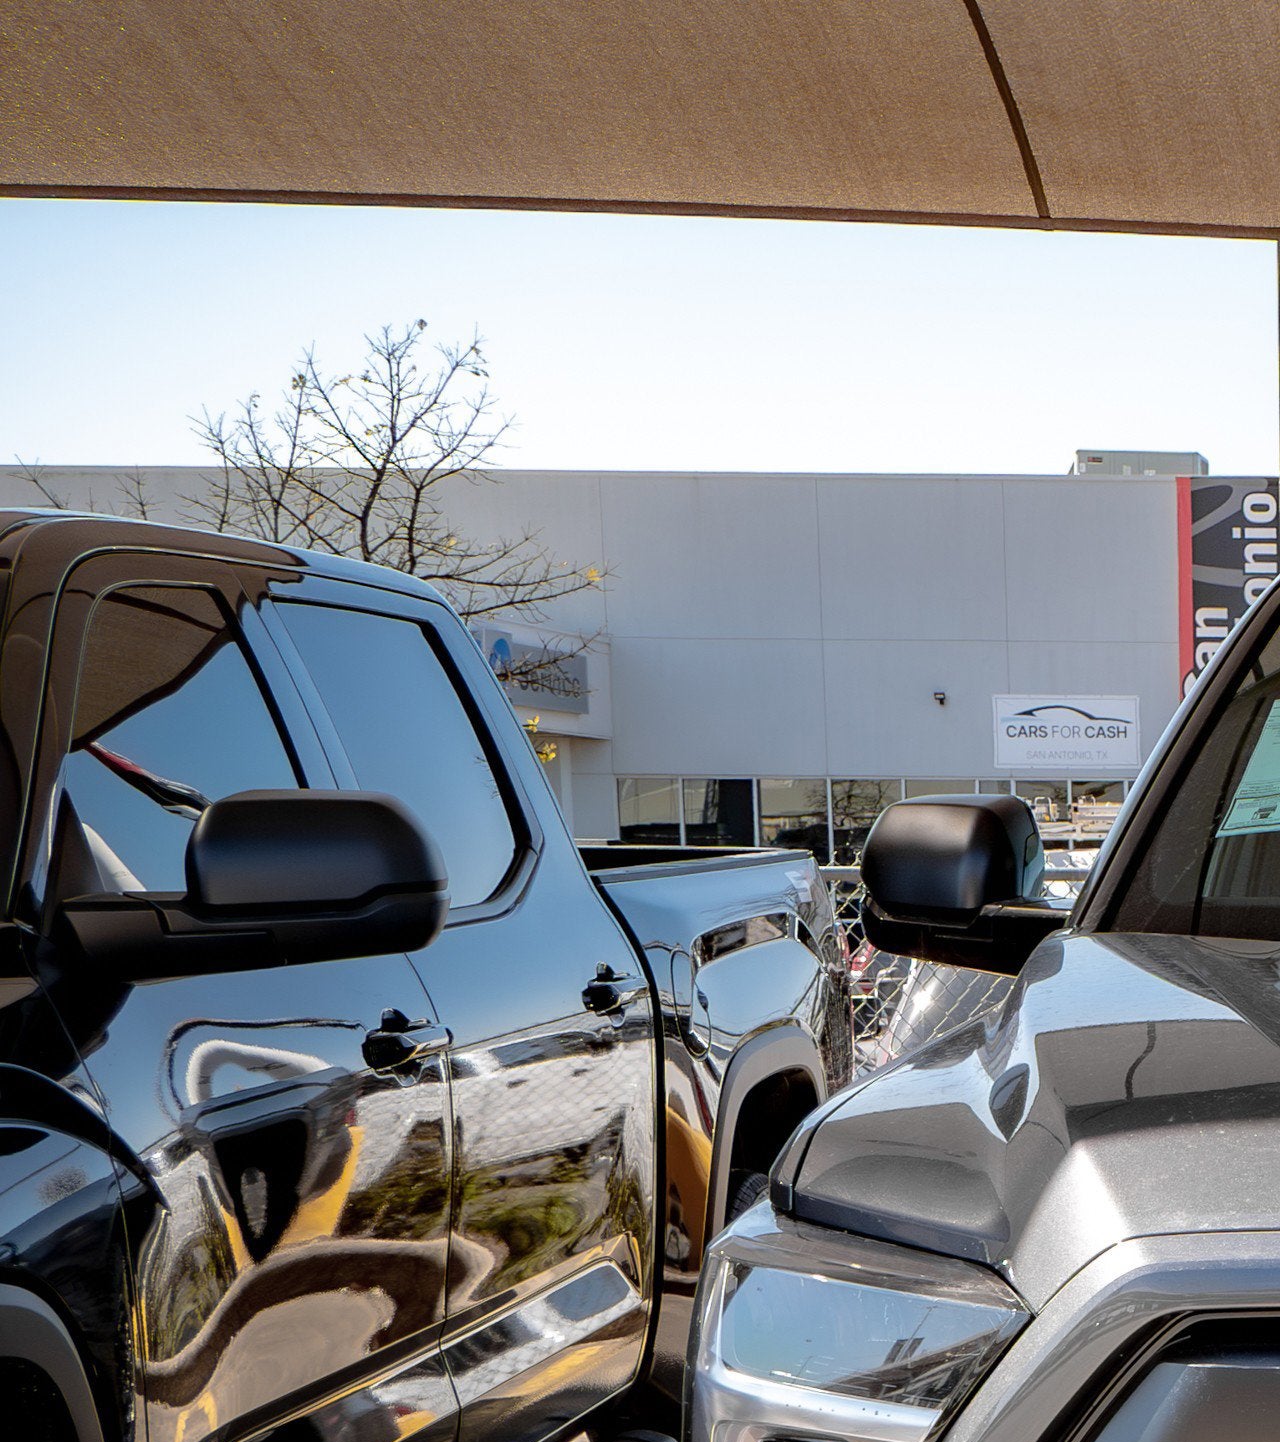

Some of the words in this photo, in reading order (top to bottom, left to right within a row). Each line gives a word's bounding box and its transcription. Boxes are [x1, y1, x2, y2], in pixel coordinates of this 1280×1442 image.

[1006, 725, 1048, 738] CARS
[1051, 725, 1081, 738] FOR
[1084, 725, 1128, 738] CASH
[1026, 750, 1046, 760] SAN
[1096, 750, 1108, 760] TX
